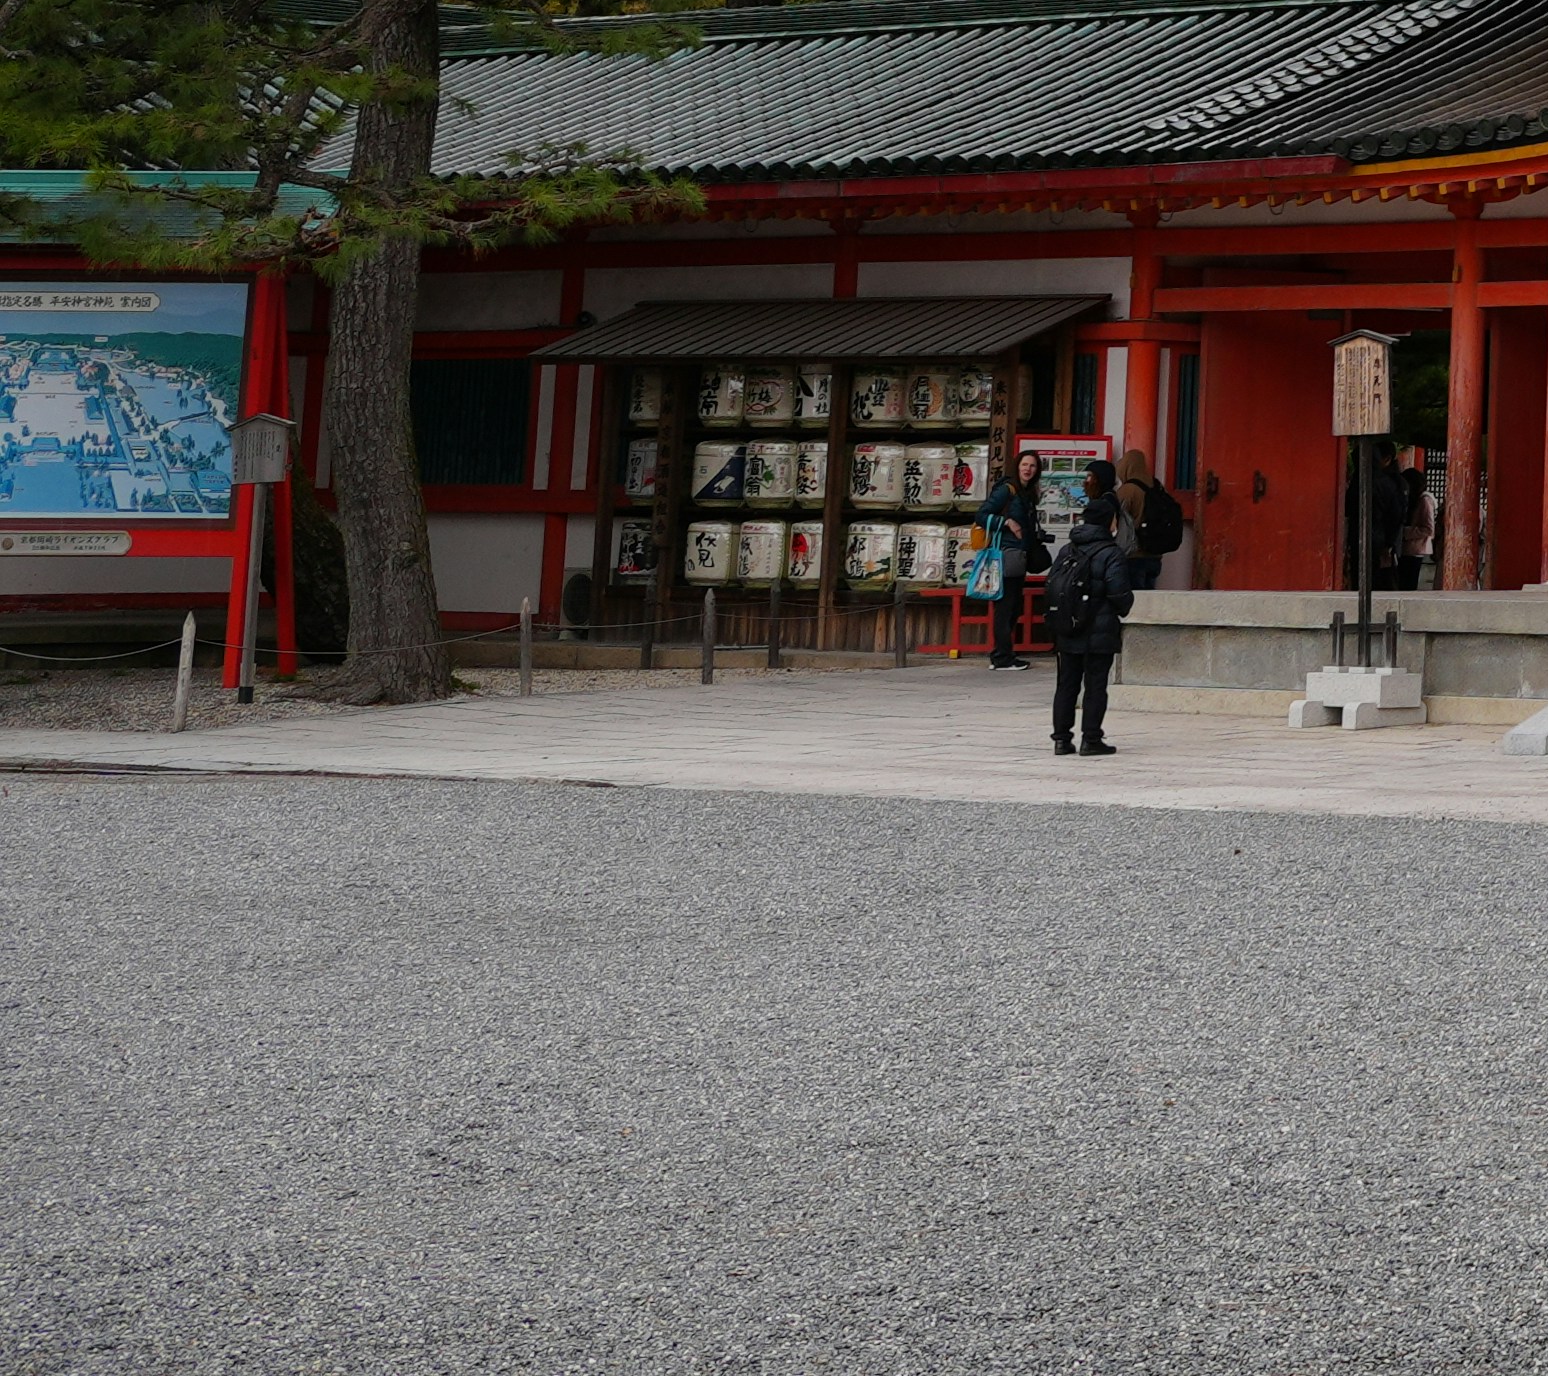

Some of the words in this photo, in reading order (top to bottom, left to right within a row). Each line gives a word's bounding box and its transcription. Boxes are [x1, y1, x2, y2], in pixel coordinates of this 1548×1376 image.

[0, 296, 43, 308] 指定名勝
[50, 295, 114, 308] 平安神宮神苑
[814, 377, 829, 414] 月の桂
[913, 375, 931, 419] 月桂冠
[994, 380, 1008, 416] 奉献
[903, 460, 923, 505] 英勲
[695, 532, 716, 568] 伏見
[898, 535, 917, 579] 神聖
